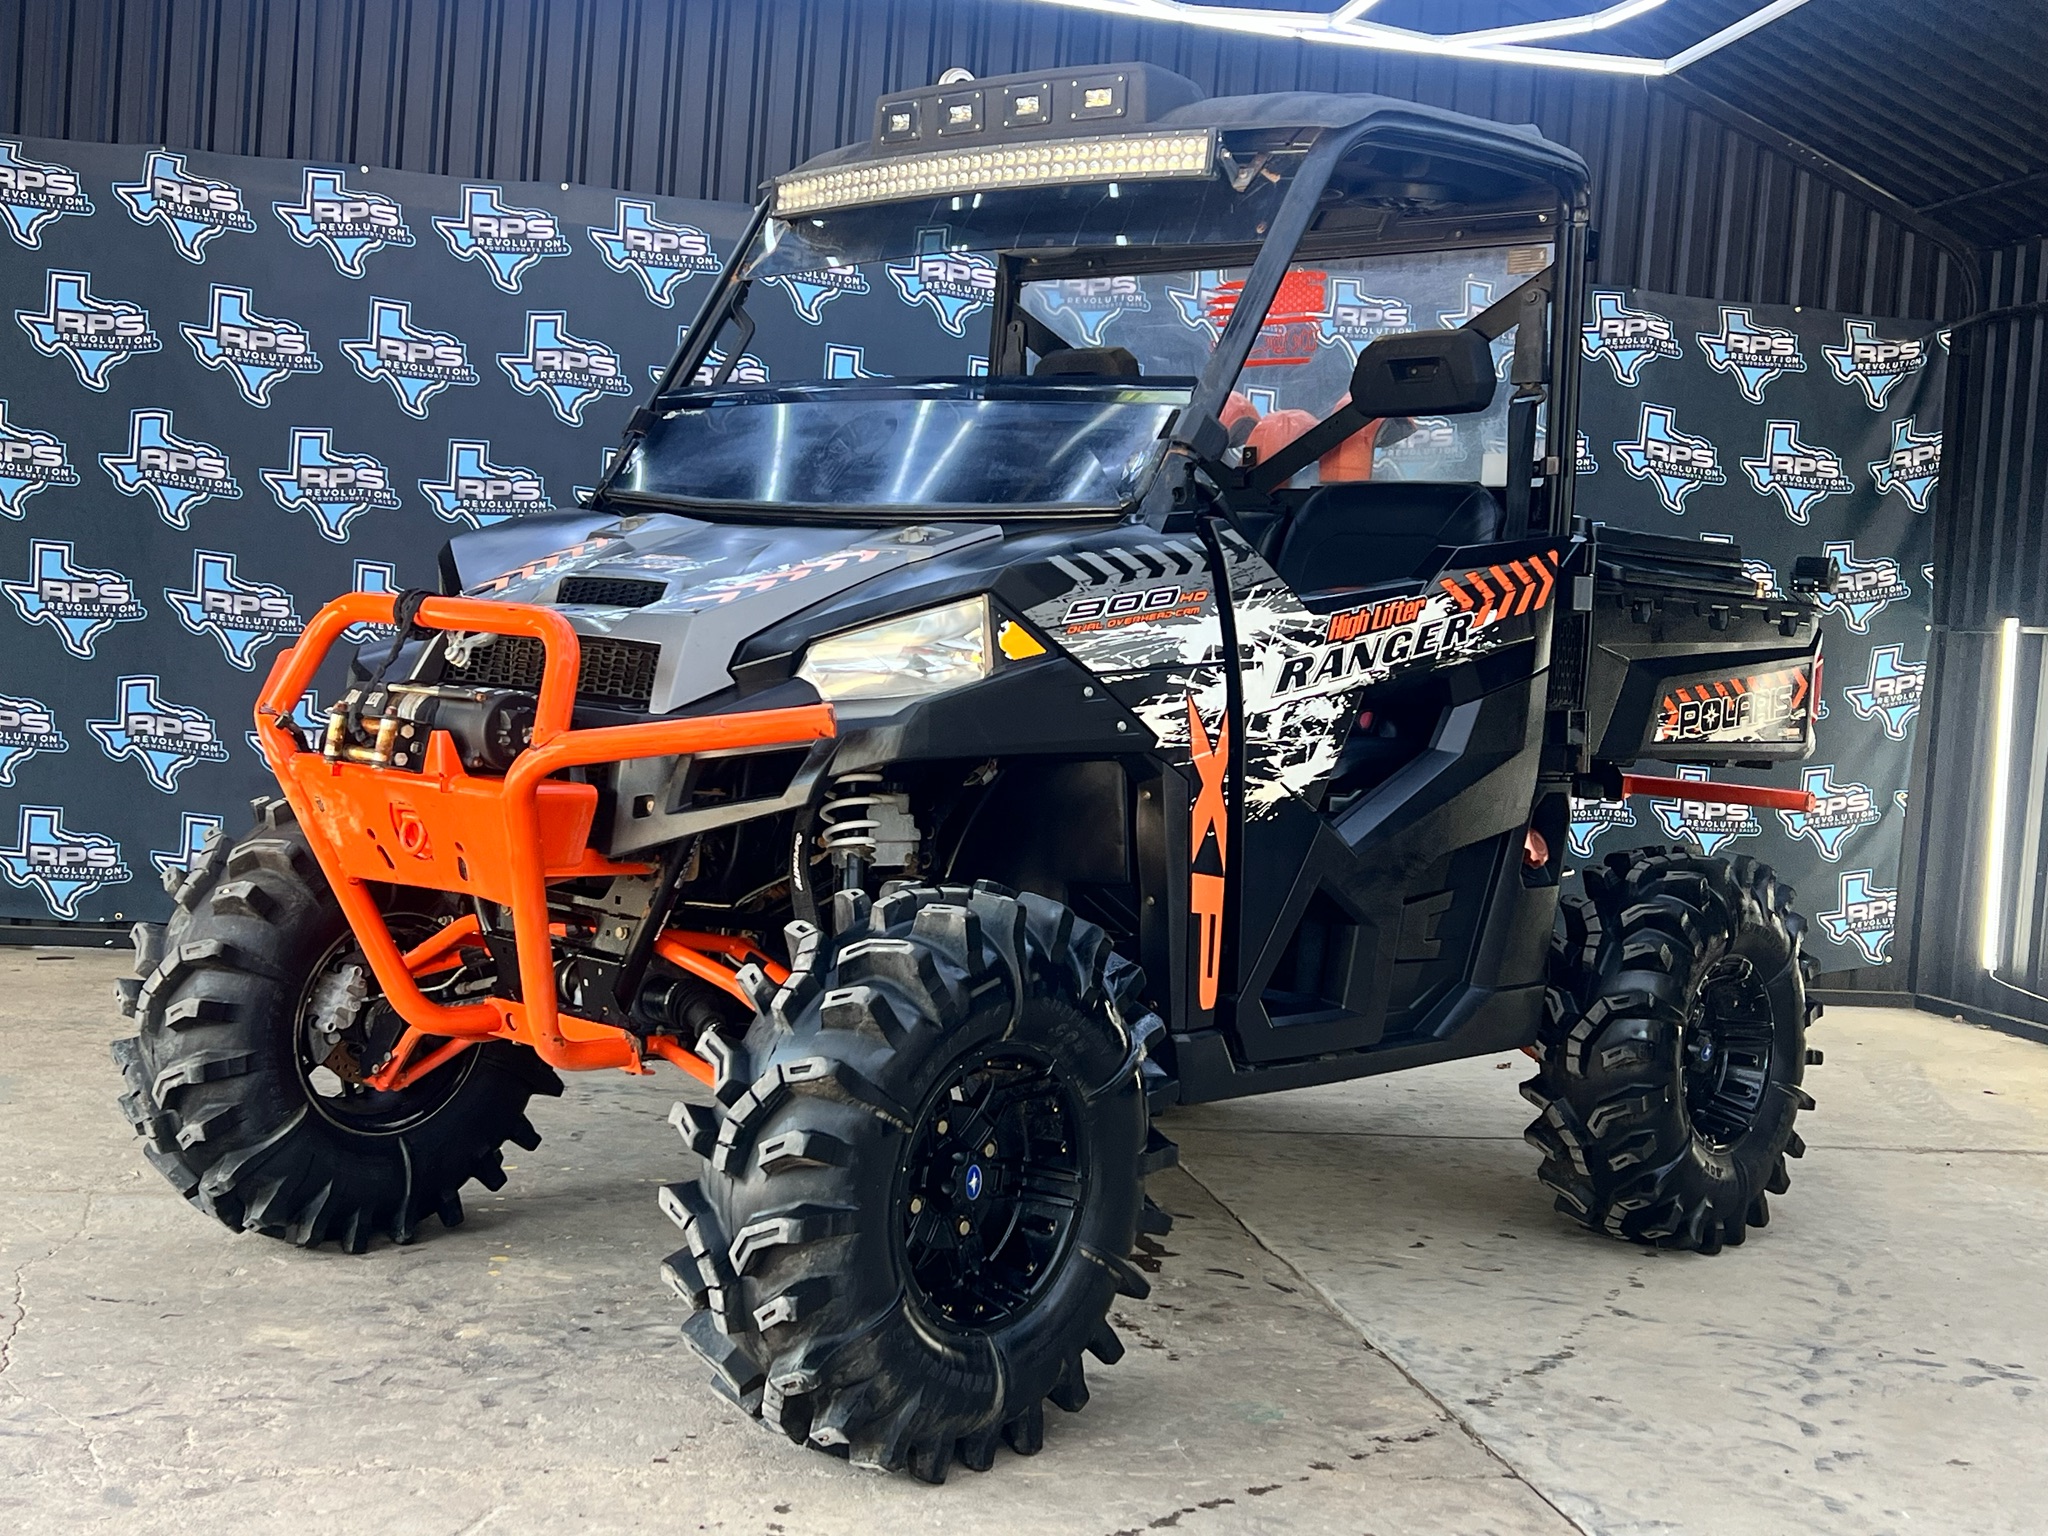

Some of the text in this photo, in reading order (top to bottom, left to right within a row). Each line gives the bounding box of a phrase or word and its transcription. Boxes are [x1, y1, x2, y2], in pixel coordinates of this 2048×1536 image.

[0, 166, 76, 197] RPS
[2, 188, 83, 206] EVOLUTION
[154, 178, 238, 212] RPS
[159, 200, 244, 221] REVOLUTION
[314, 201, 398, 226] RPS
[320, 223, 404, 236] REVOLUTION
[472, 216, 554, 240] RPS
[477, 237, 561, 247] REVOLUTION
[626, 229, 706, 256] RPS
[631, 250, 712, 264] REVOLUTION
[921, 261, 996, 289] RPS
[926, 281, 995, 297] REVOLUTIO
[1063, 276, 1137, 296] RPS
[1067, 294, 1142, 304] REVOLUTION
[58, 311, 145, 336] RPS
[1336, 306, 1408, 327] RPS
[62, 333, 151, 344] REVOLUTION
[220, 325, 305, 355] RPS
[1340, 326, 1412, 335] REVOLUTION
[1603, 320, 1670, 340] RPS
[380, 338, 463, 367] RPS
[1605, 338, 1675, 350] REVOLUTION
[1727, 333, 1794, 356] RPS
[1854, 341, 1920, 363] RPS
[225, 347, 311, 364] REVOLUTION
[536, 348, 616, 376] RPS
[1731, 352, 1798, 363] REVOLUTION
[1857, 357, 1922, 370] REVOLUTION
[384, 360, 469, 376] REVOLUTION
[541, 370, 622, 385] REVOLUTION
[1395, 428, 1453, 448] PS
[140, 446, 225, 480] RPS
[1647, 439, 1714, 469] RPS
[0, 462, 69, 476] VOLUTION
[1650, 459, 1718, 477] REVOLUTION
[1772, 454, 1839, 478] RPS
[1893, 462, 1940, 478] REVOLUT
[145, 468, 231, 489] REVOLUTION
[301, 467, 384, 489] RPS
[1775, 474, 1844, 486] REVOLUTION
[305, 487, 390, 501] REVOLUTION
[458, 478, 540, 501] RPS
[463, 500, 546, 509] REVOLUTION
[1836, 567, 1897, 592] RPS
[42, 580, 129, 604] RPS
[1838, 584, 1903, 599] REVOLUTION
[47, 602, 136, 612] REVOLUTION
[205, 590, 290, 618] RPS
[1061, 586, 1181, 624] 900
[210, 612, 296, 627] REVOLUTION
[1067, 607, 1200, 634] DUAL OVERHEAD CAM
[1327, 598, 1427, 641] High Lifter
[1272, 612, 1473, 696] RANGER
[1877, 691, 1922, 705] REVOLUT
[1678, 684, 1792, 738] POLARIS
[0, 710, 51, 734] PS
[128, 712, 212, 742] RPS
[0, 731, 58, 743] LUTION
[133, 734, 218, 752] REVOLUTION
[1573, 809, 1628, 818] VOLUTION
[1682, 800, 1749, 821] RPS
[1805, 793, 1870, 818] RPS
[1686, 819, 1753, 828] REVOLUTION
[1808, 810, 1874, 825] REVOLUTION
[30, 845, 116, 867] RPS
[35, 865, 122, 875] REVOLUTION
[1850, 917, 1894, 929] REVOLUT
